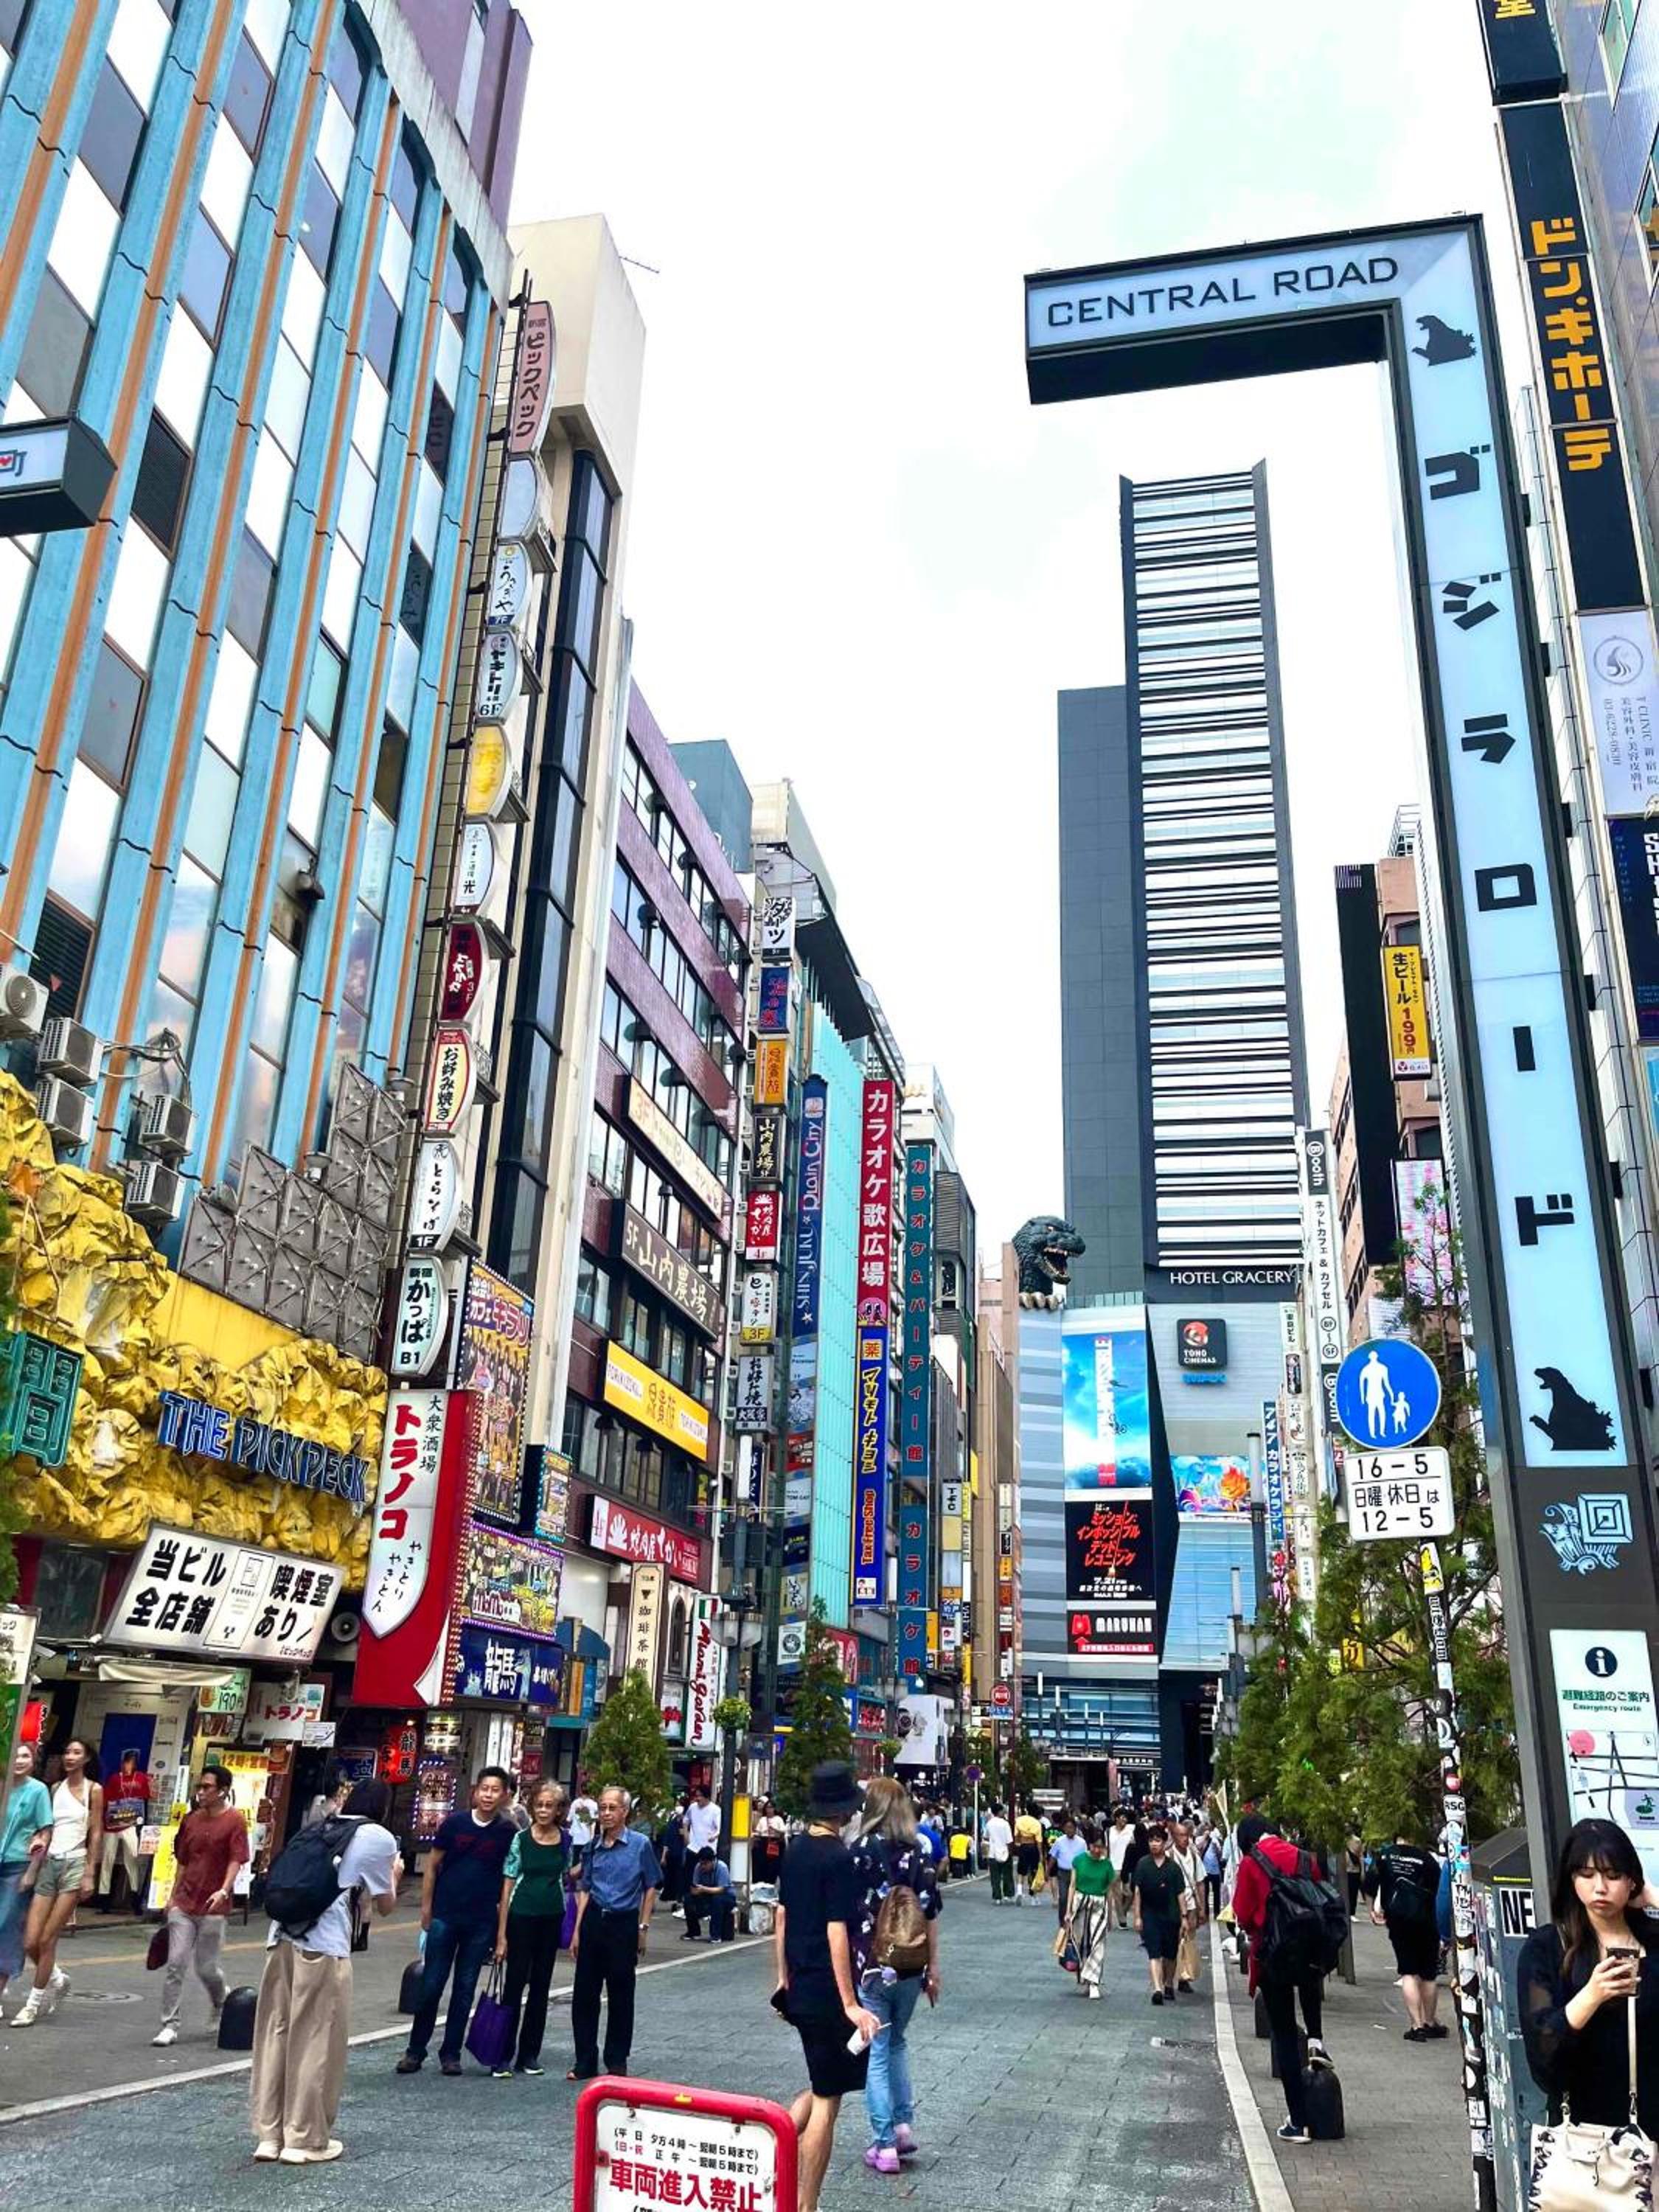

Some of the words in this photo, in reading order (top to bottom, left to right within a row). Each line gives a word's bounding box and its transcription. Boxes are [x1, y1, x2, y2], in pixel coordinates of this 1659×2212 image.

[1048, 279, 1256, 327] CENTRAL
[1273, 257, 1398, 295] ROAD
[515, 334, 544, 437] ピックペック
[480, 704, 504, 717] 6F
[1425, 445, 1574, 1245] ゴジラロード
[1393, 953, 1411, 1004] 生ビール
[436, 1046, 459, 1121] お好み焼き
[757, 1118, 775, 1170] 山内農場
[1307, 1141, 1325, 1186] Booth
[423, 1163, 444, 1231] とらそば
[861, 1090, 888, 1287] カラオケ歌広場
[416, 1236, 434, 1248] 1F
[1315, 1201, 1328, 1254] ネットカフェ
[409, 1267, 434, 1279] 新宿
[639, 1230, 708, 1321] 山内農場
[796, 1227, 817, 1309] SHINJUKU
[1170, 1272, 1219, 1285] HOTEL
[1223, 1270, 1293, 1284] GRACERY
[1320, 1270, 1332, 1310] カプセル
[401, 1279, 431, 1344] かっぱ
[750, 1328, 765, 1340] 3F
[400, 1352, 420, 1365] B1
[159, 1389, 230, 1460] THE
[420, 1394, 443, 1474] 大衆酒場
[378, 1404, 421, 1540] トラノコ
[146, 1539, 226, 1587] 当ビル
[269, 1563, 334, 1607] 喫煙室
[372, 1553, 401, 1613] やきとん
[394, 1540, 422, 1600] やきとり
[125, 1587, 216, 1635] 全店舗
[904, 1522, 922, 1674] カラオケ館
[1096, 1617, 1152, 1632] MARUHAN
[484, 1637, 518, 1695] 龍馬
[1561, 1688, 1651, 1703] 避難経路のご案内
[1573, 1703, 1618, 1713] Emergency
[610, 2157, 763, 2212] 車両進入禁止
